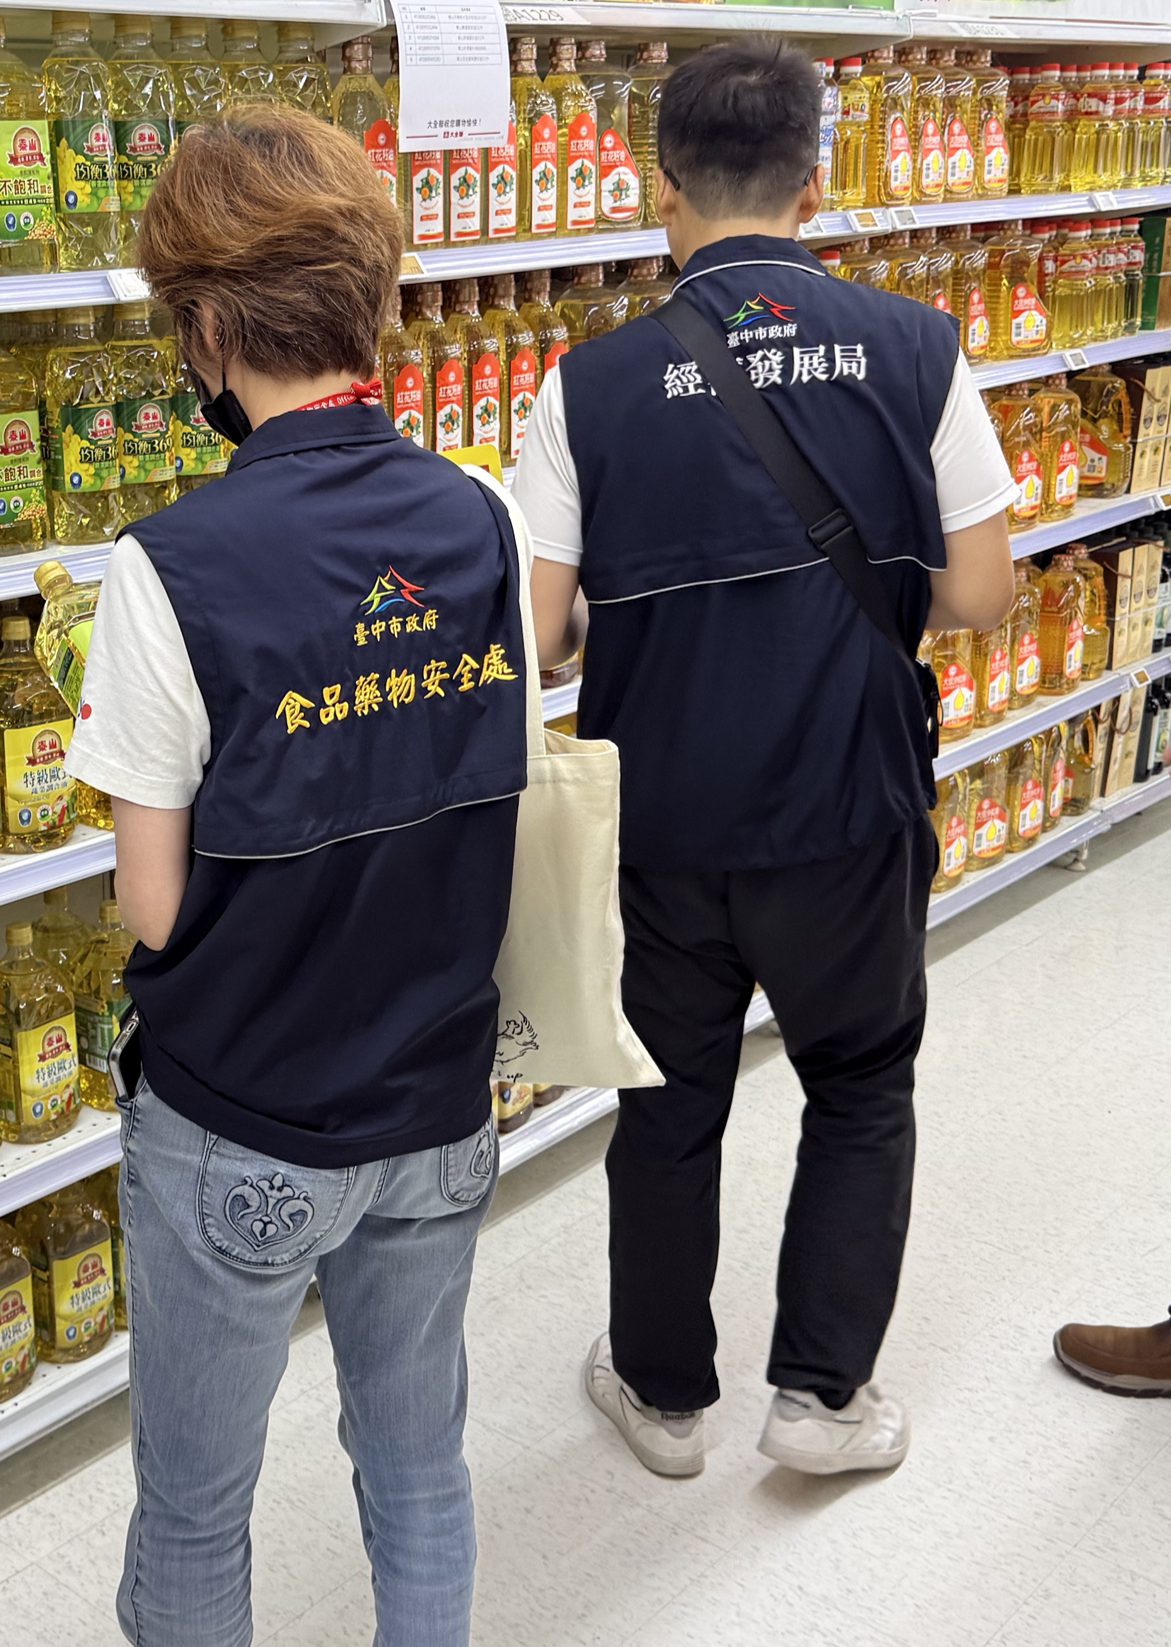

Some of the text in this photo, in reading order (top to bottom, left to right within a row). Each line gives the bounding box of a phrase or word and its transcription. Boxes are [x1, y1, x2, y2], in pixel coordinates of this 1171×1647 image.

[18, 137, 37, 151] 泰山
[137, 132, 156, 143] 泰山
[726, 323, 798, 348] 臺中市政府
[663, 343, 867, 399] 經發展局
[142, 411, 158, 421] 泰山
[9, 428, 27, 442] 泰山
[123, 437, 173, 455] 均衡369
[353, 608, 439, 647] 臺中市政府
[275, 643, 519, 734] 食品藥物安全處
[37, 738, 57, 752] 泰山
[46, 1033, 66, 1048] 泰山
[35, 1053, 77, 1084] 特級歐式
